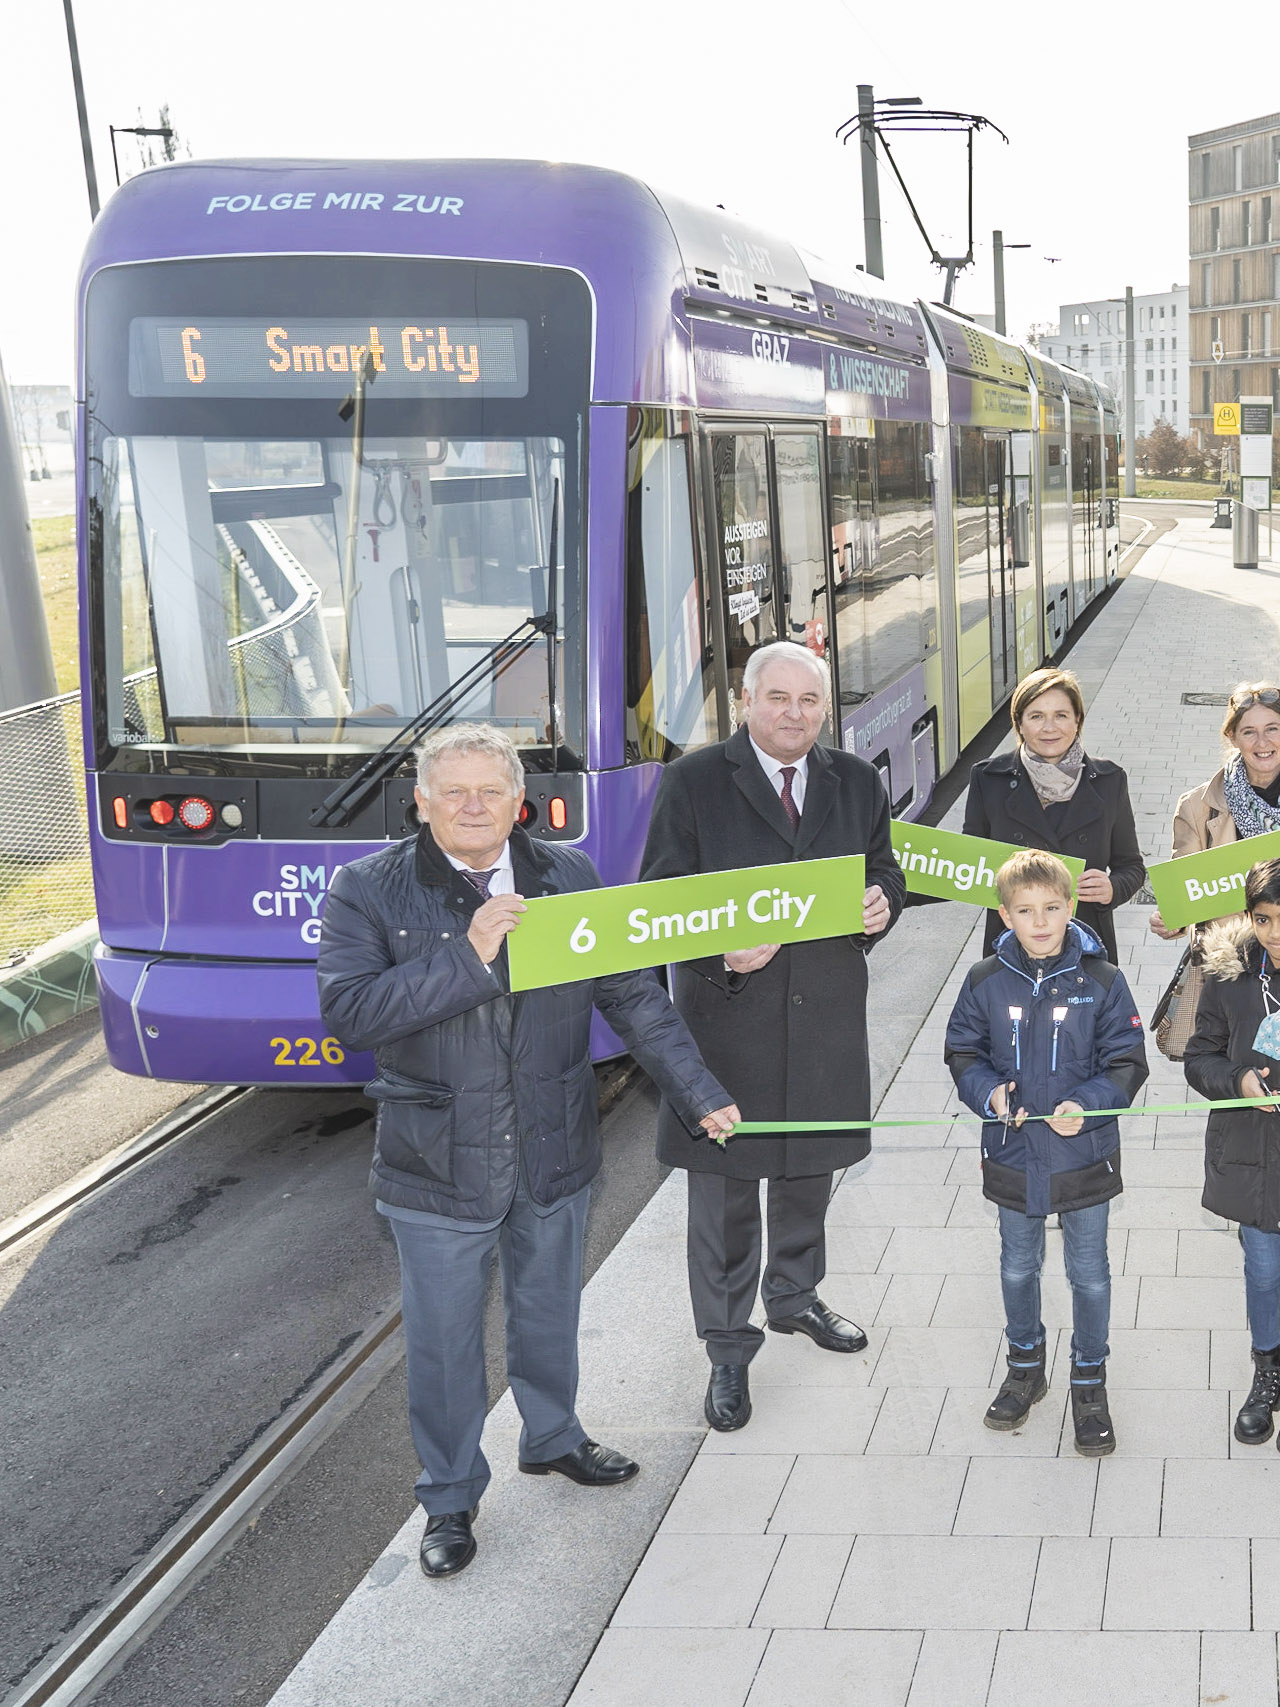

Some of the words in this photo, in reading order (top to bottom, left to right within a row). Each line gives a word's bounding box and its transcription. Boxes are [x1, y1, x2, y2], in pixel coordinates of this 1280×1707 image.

[207, 192, 316, 215] FOLGE
[323, 192, 385, 212] MIR
[393, 194, 464, 216] ZUR
[181, 327, 207, 384] 6
[265, 326, 385, 373] Smart
[401, 326, 480, 384] City
[752, 332, 792, 368] GRAZ
[829, 353, 839, 390] &
[840, 355, 910, 400] WISSENSCHAFT
[724, 520, 768, 544] AUSSTEIGEN
[725, 547, 741, 565] VOR
[726, 563, 767, 588] EINSTEIGEN
[252, 891, 325, 917] CITY
[569, 917, 597, 954] 6
[627, 904, 739, 944] Smart
[747, 887, 816, 928] City
[270, 1037, 345, 1065] 226
